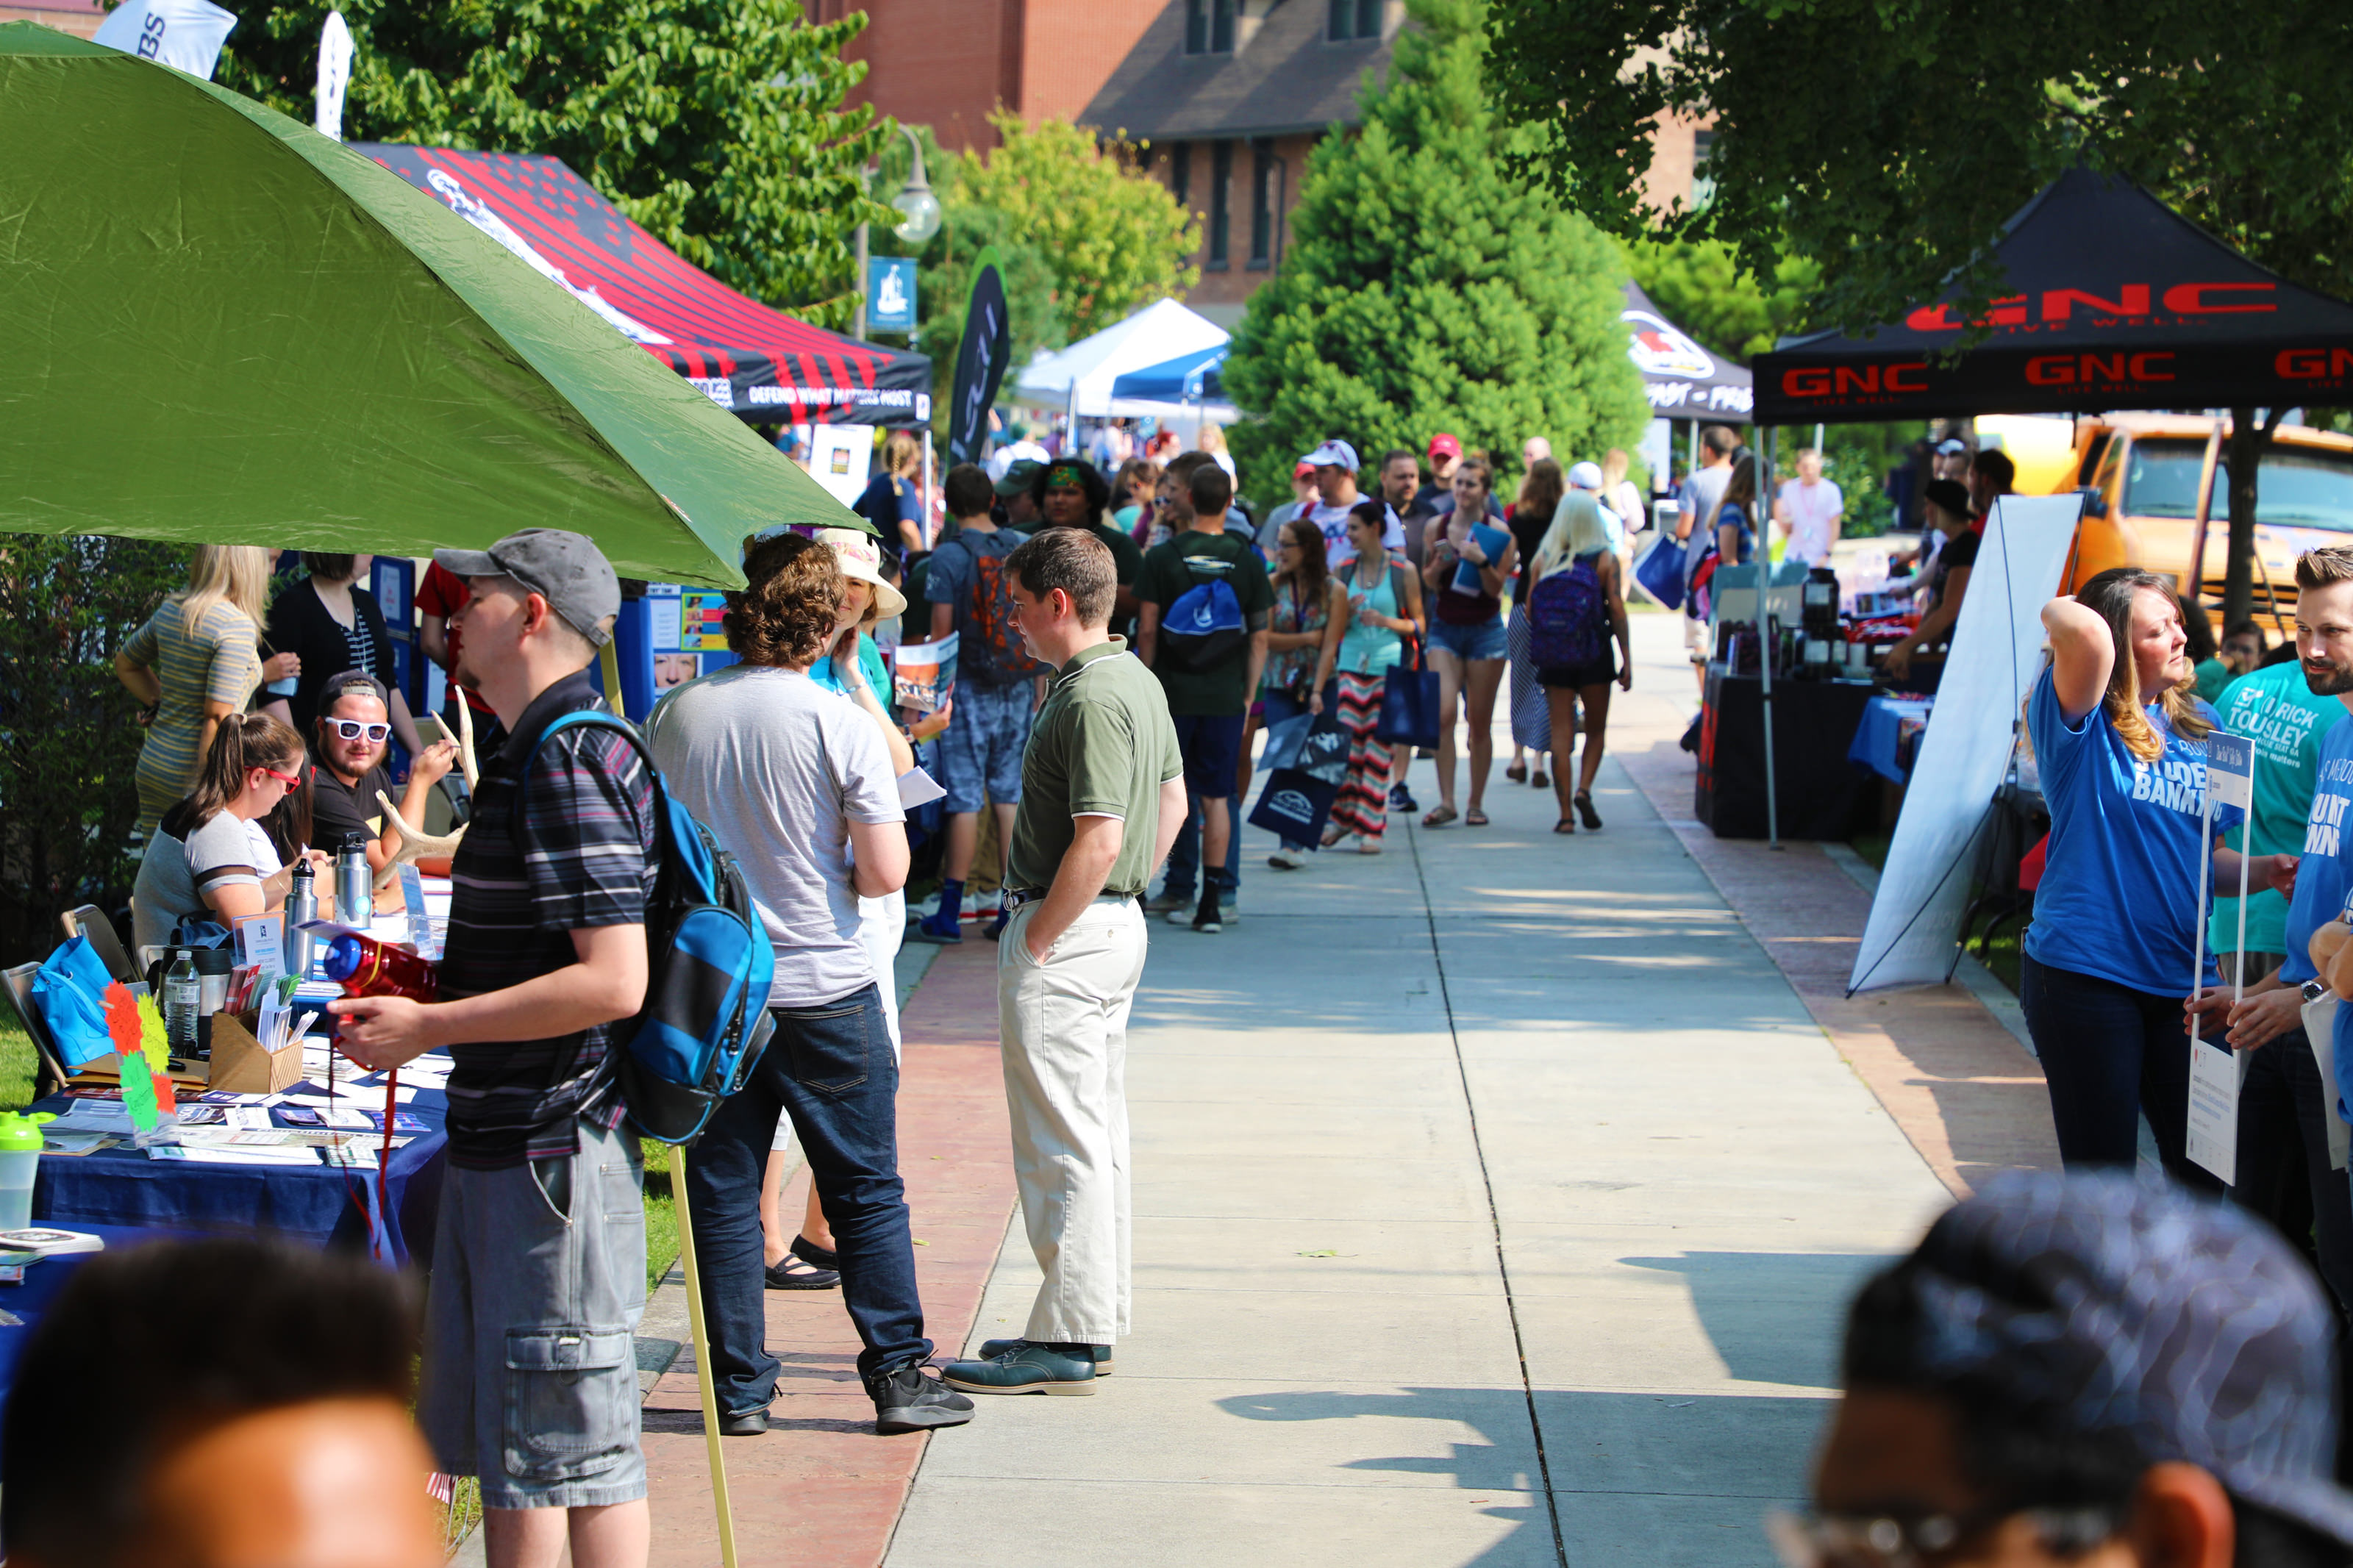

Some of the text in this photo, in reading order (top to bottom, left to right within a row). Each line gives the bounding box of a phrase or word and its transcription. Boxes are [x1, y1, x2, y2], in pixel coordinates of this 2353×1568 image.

[1906, 282, 2277, 332] GNC
[1782, 362, 1929, 398] GNC
[2024, 351, 2176, 386] GNC
[2058, 385, 2091, 394] LIVE
[2308, 379, 2343, 389] LIVE
[749, 386, 797, 404] DEFEND
[797, 387, 832, 405] WHAT
[880, 389, 913, 407] MOST
[1813, 397, 1846, 406] LIVE
[2228, 706, 2309, 748] TOUSLEY
[2275, 701, 2320, 729] RICK
[2269, 752, 2301, 769] matters
